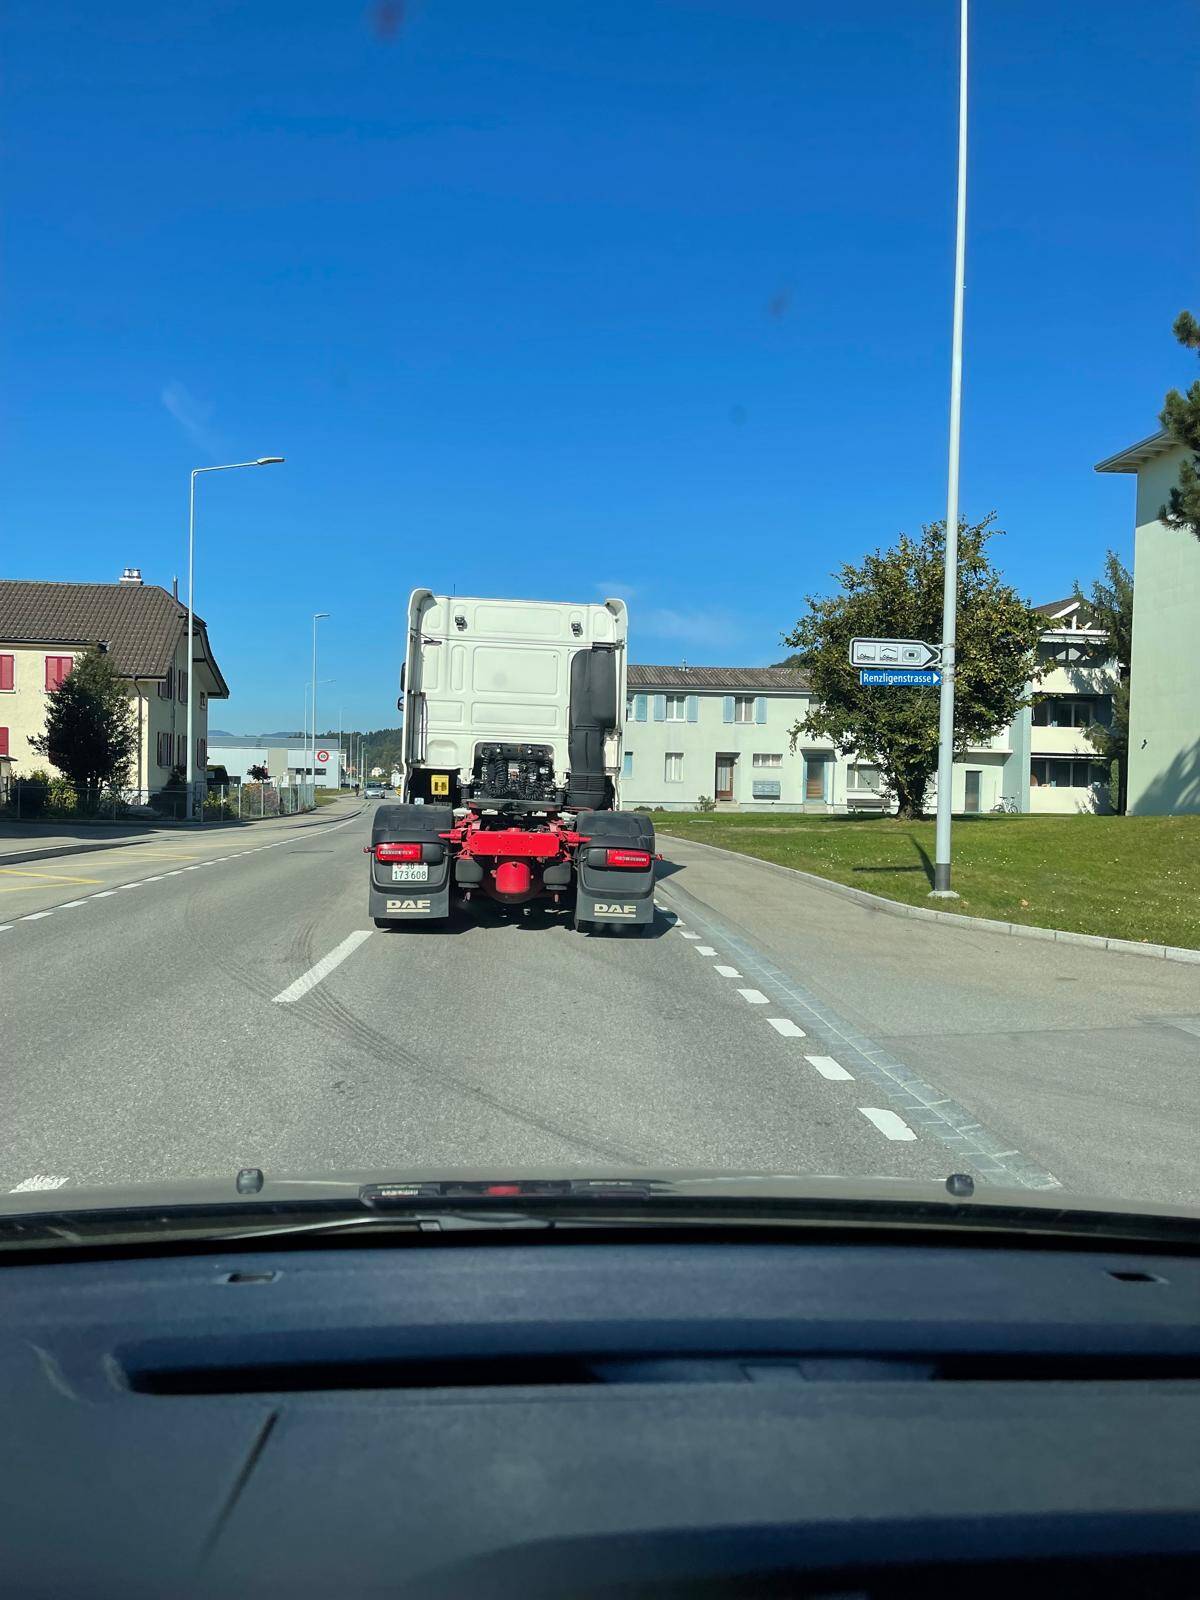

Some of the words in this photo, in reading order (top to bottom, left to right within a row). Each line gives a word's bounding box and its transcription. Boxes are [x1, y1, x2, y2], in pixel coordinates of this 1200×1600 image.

[863, 673, 931, 685] Renzligenstrasse
[387, 900, 430, 908] DAF
[594, 904, 636, 913] DAF
